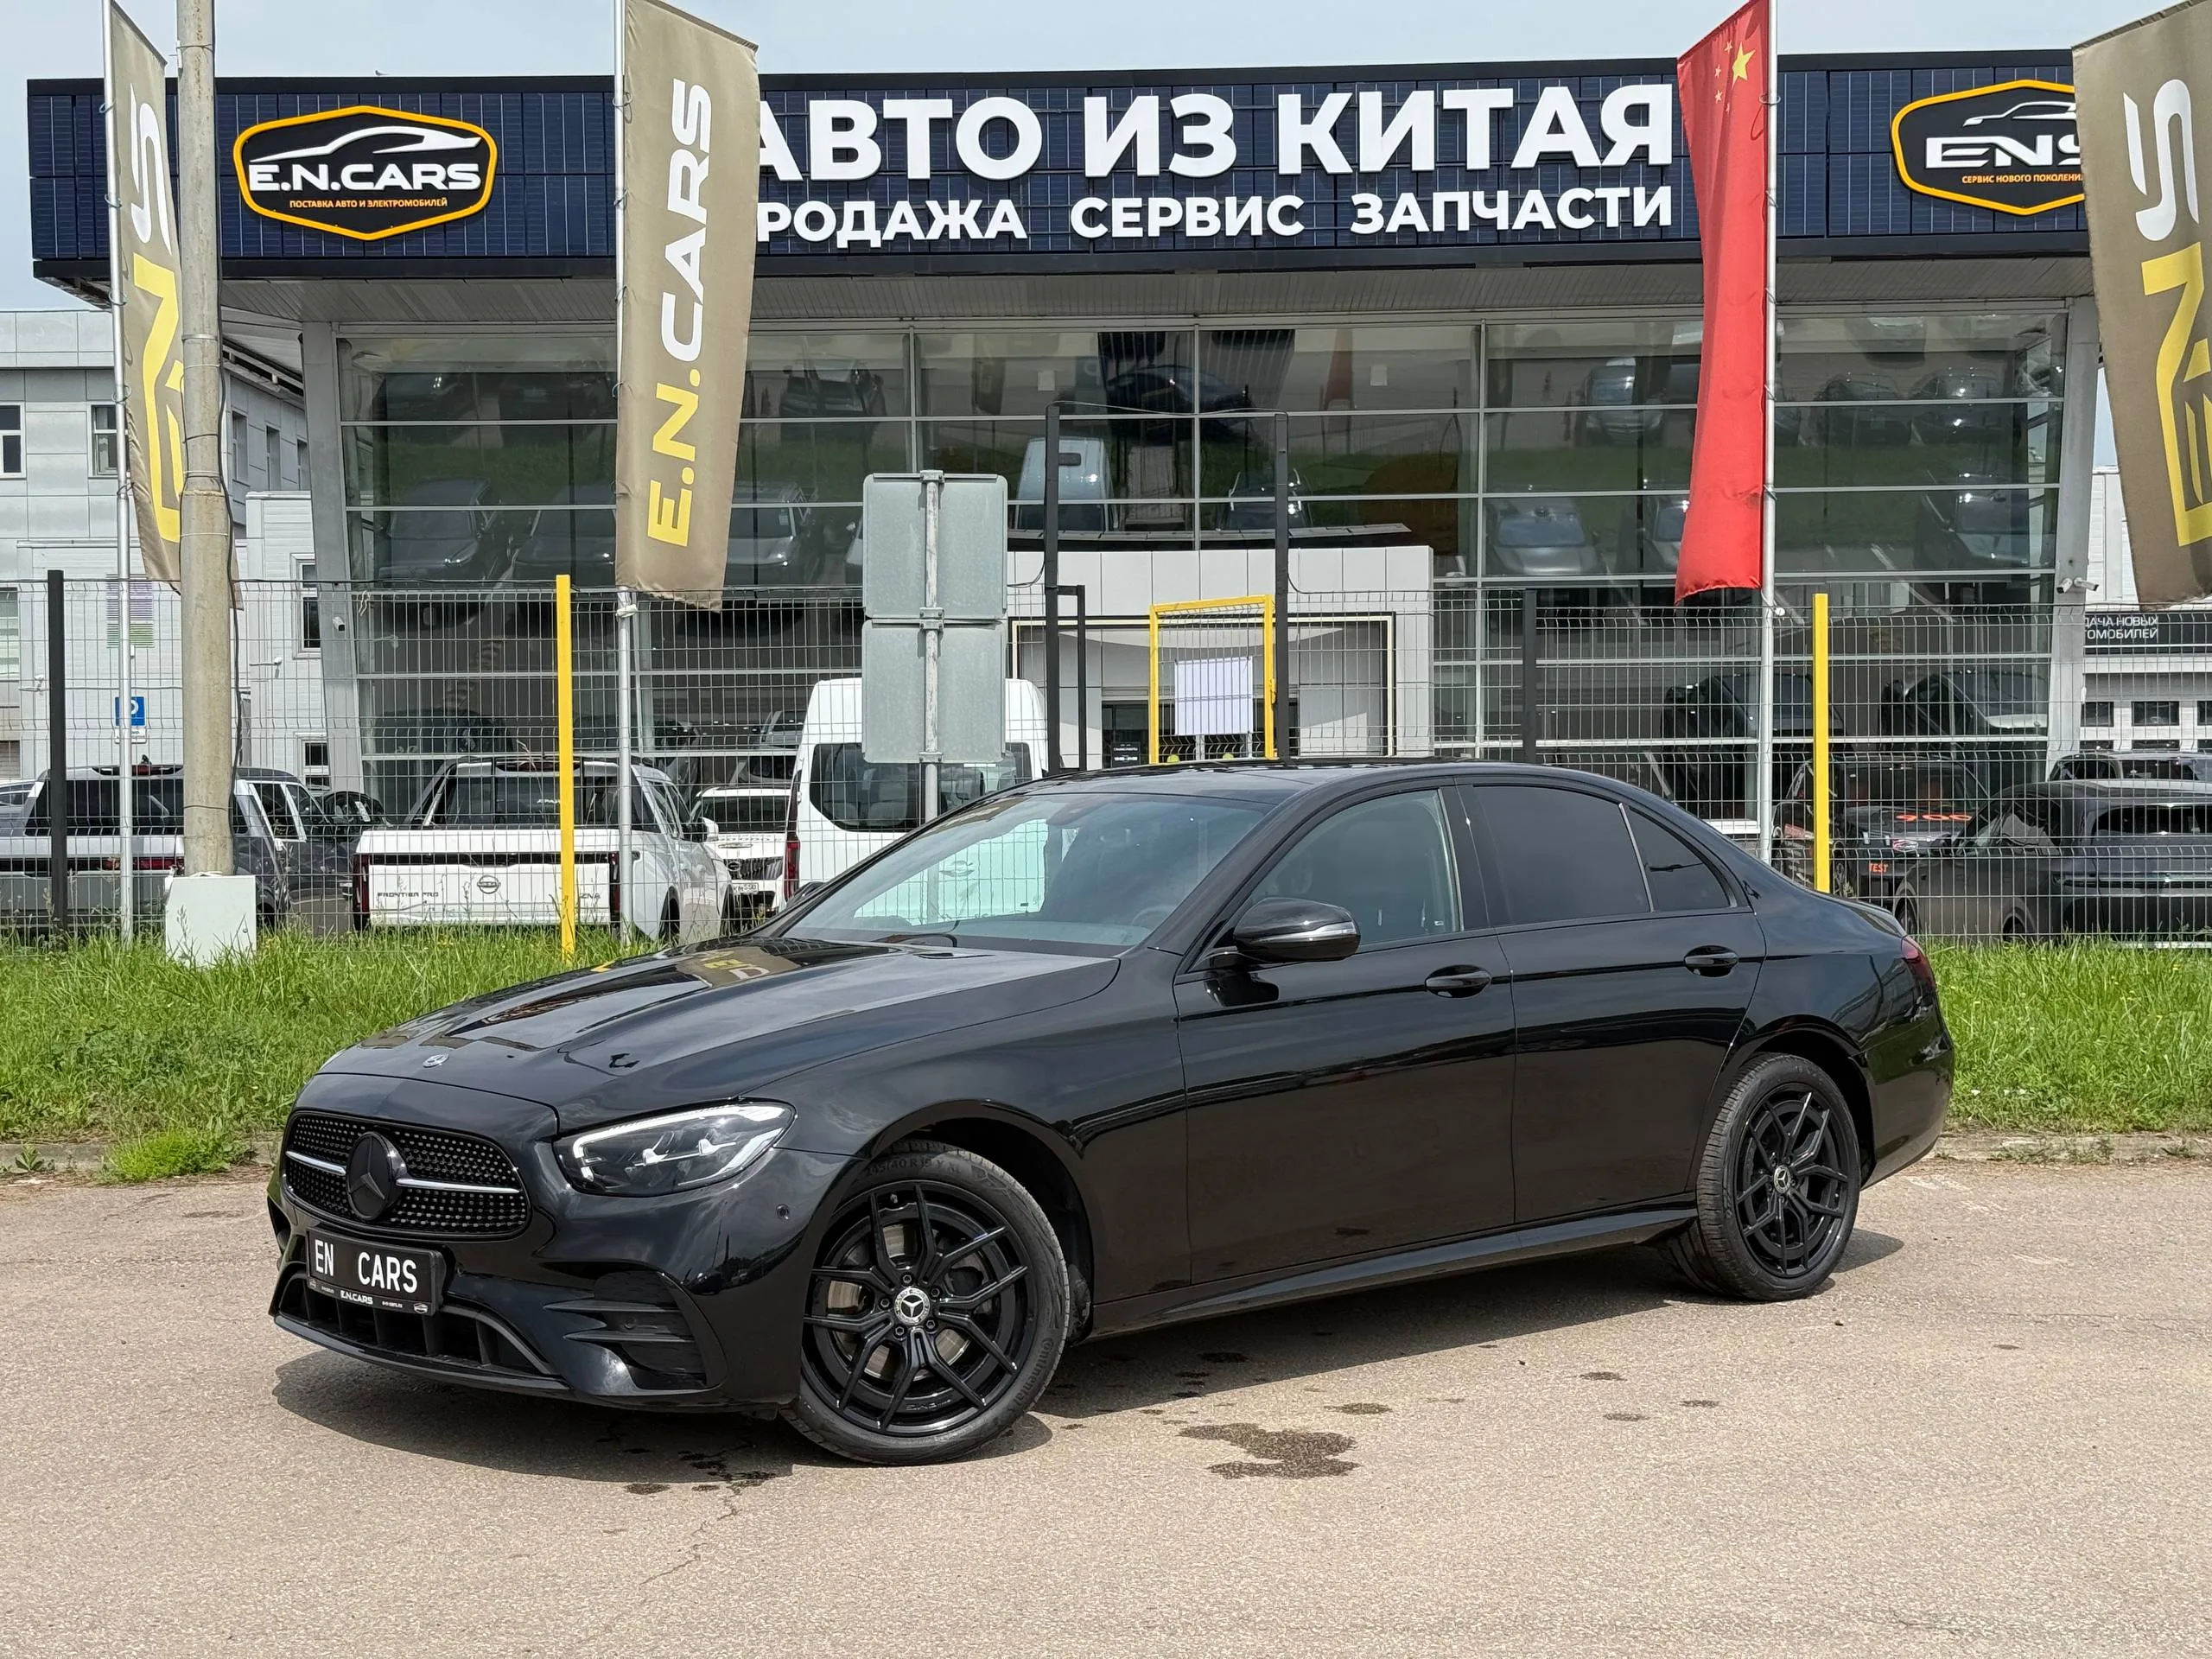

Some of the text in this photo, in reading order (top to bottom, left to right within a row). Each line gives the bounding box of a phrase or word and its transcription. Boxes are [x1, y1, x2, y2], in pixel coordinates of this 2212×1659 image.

[1084, 93, 1236, 178] ИЗ
[1277, 84, 1673, 175] КИТАЯ
[248, 162, 482, 192] E.N.CARS
[1961, 173, 2084, 184] СЕРВИС НОВОГО ПОКОЛЕНИ
[289, 197, 448, 209] ПОСТАВКА АВТО И ЭЛЕКТРОМОБИЛЕЙ
[758, 185, 1672, 250] РОДАЖА СЕРВИС ЗАПЧАСТИ
[647, 78, 713, 547] E.N.CARS
[2085, 627, 2158, 639] ОМОБИЛЕЙ
[2116, 616, 2158, 627] НОВЫХ
[1868, 862, 1889, 873] TEST
[315, 1238, 418, 1294] EN CARS
[1014, 1337, 1054, 1406] Continental
